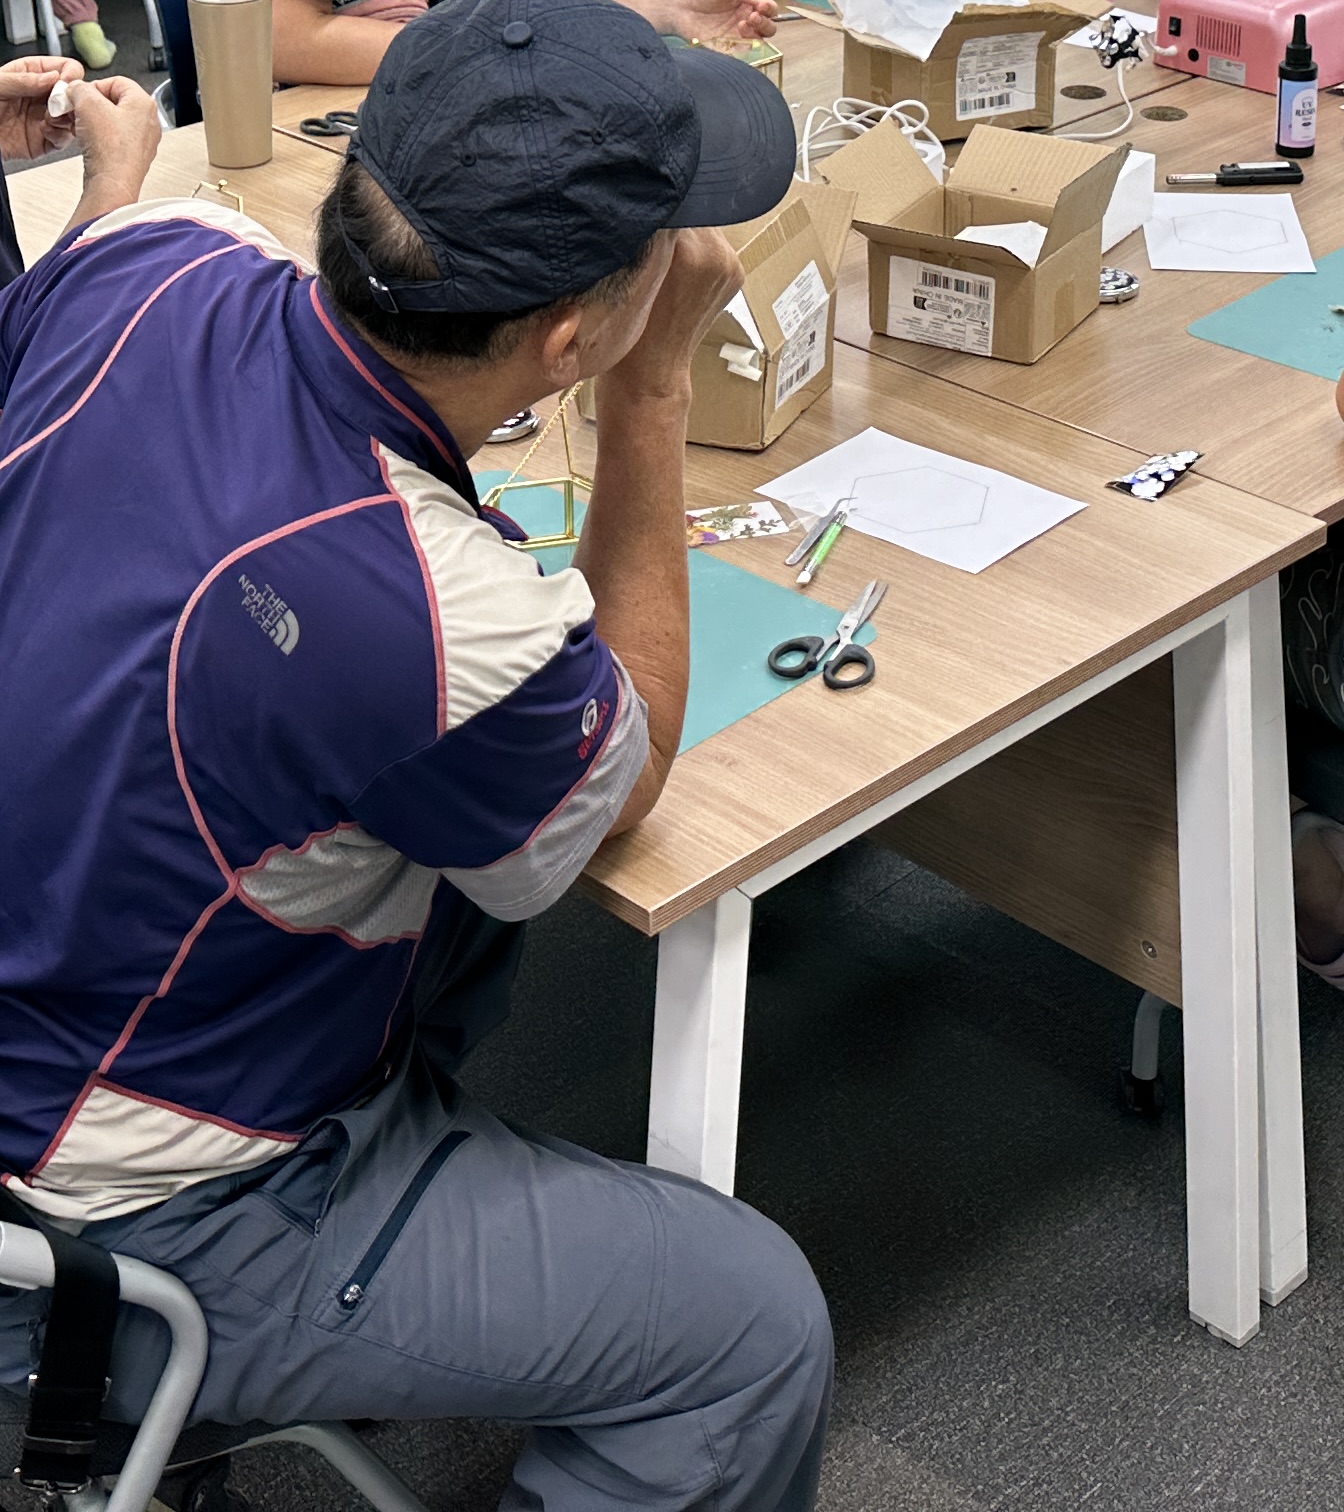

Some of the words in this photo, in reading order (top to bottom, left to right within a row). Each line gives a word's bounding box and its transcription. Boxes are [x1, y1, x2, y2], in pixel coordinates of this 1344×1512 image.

[238, 573, 281, 627] NORTH
[241, 595, 272, 634] FACE
[262, 583, 289, 615] THE
